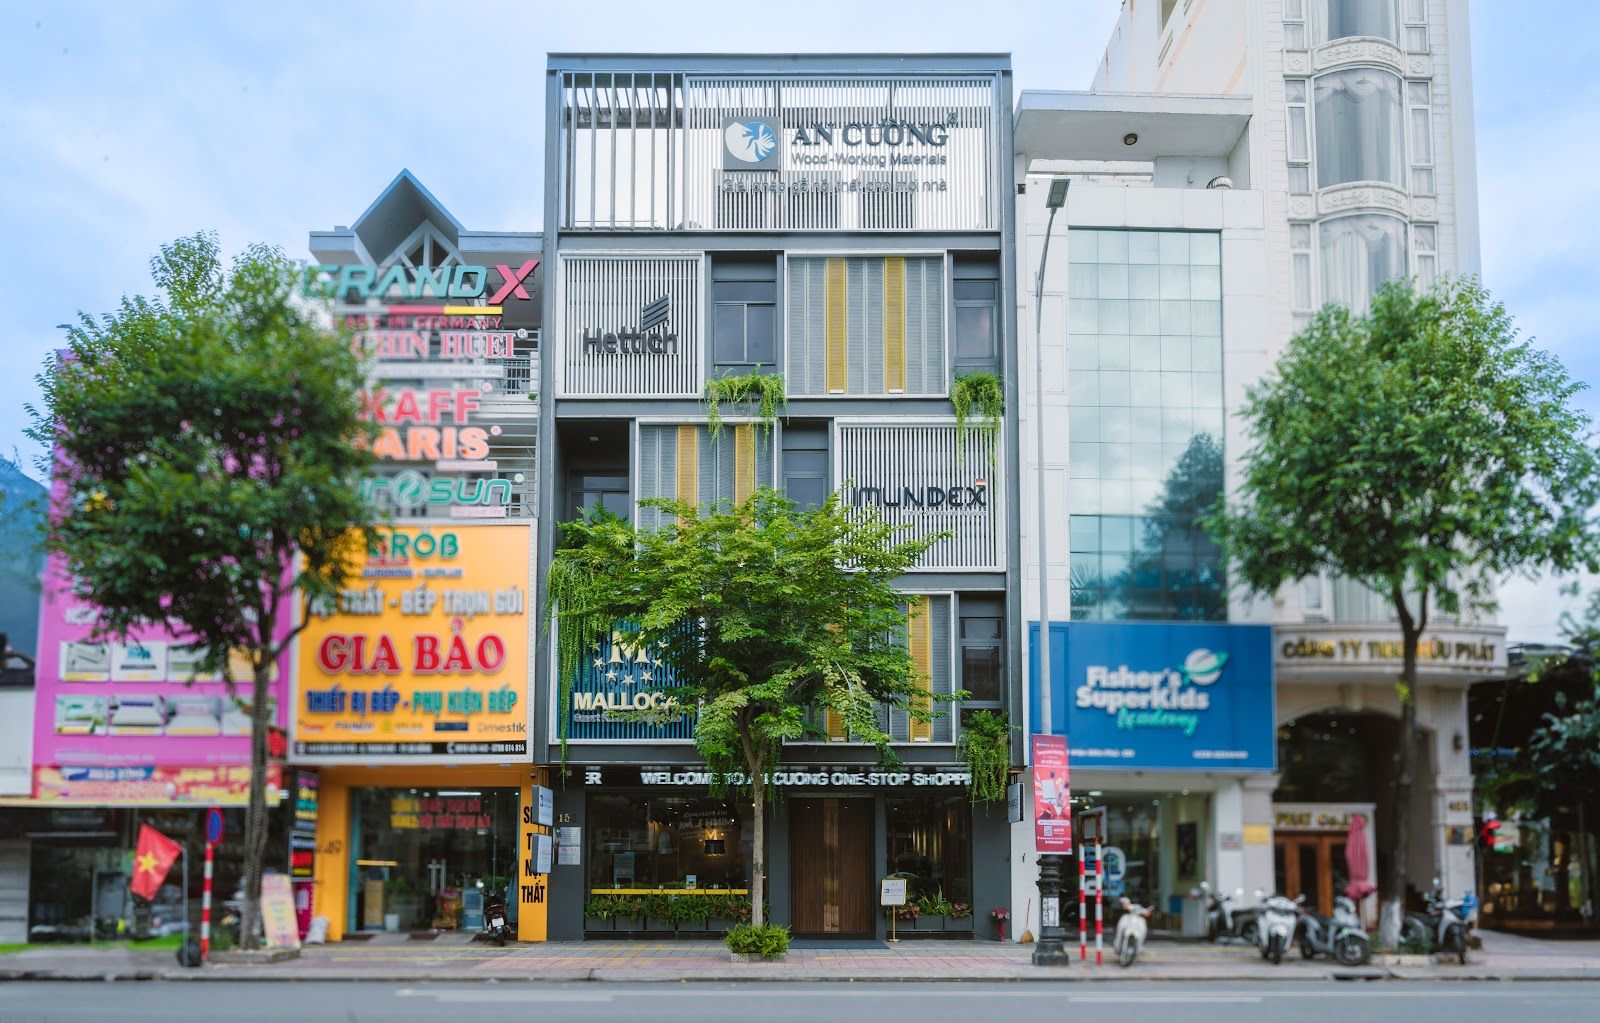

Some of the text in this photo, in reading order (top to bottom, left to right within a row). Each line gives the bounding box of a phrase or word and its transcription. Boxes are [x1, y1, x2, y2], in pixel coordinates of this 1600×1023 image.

[792, 117, 949, 147] AN CƯỜNG
[890, 153, 948, 165] Materials
[751, 180, 786, 196] pháp
[836, 178, 862, 193] thất
[866, 179, 891, 193] cho
[896, 179, 919, 196] mọi
[923, 178, 948, 193] nhà
[414, 315, 503, 330] GERMANY
[439, 331, 517, 359] HUEI
[583, 326, 678, 354] Hettich
[352, 426, 490, 460] ARIS
[851, 486, 987, 507] IMUNDEX
[319, 616, 507, 676] GIA BẢO
[1086, 664, 1183, 688] Fisher's
[487, 683, 518, 714] BẾP
[1076, 683, 1210, 715] SuperKids
[521, 879, 545, 903] THẤT
